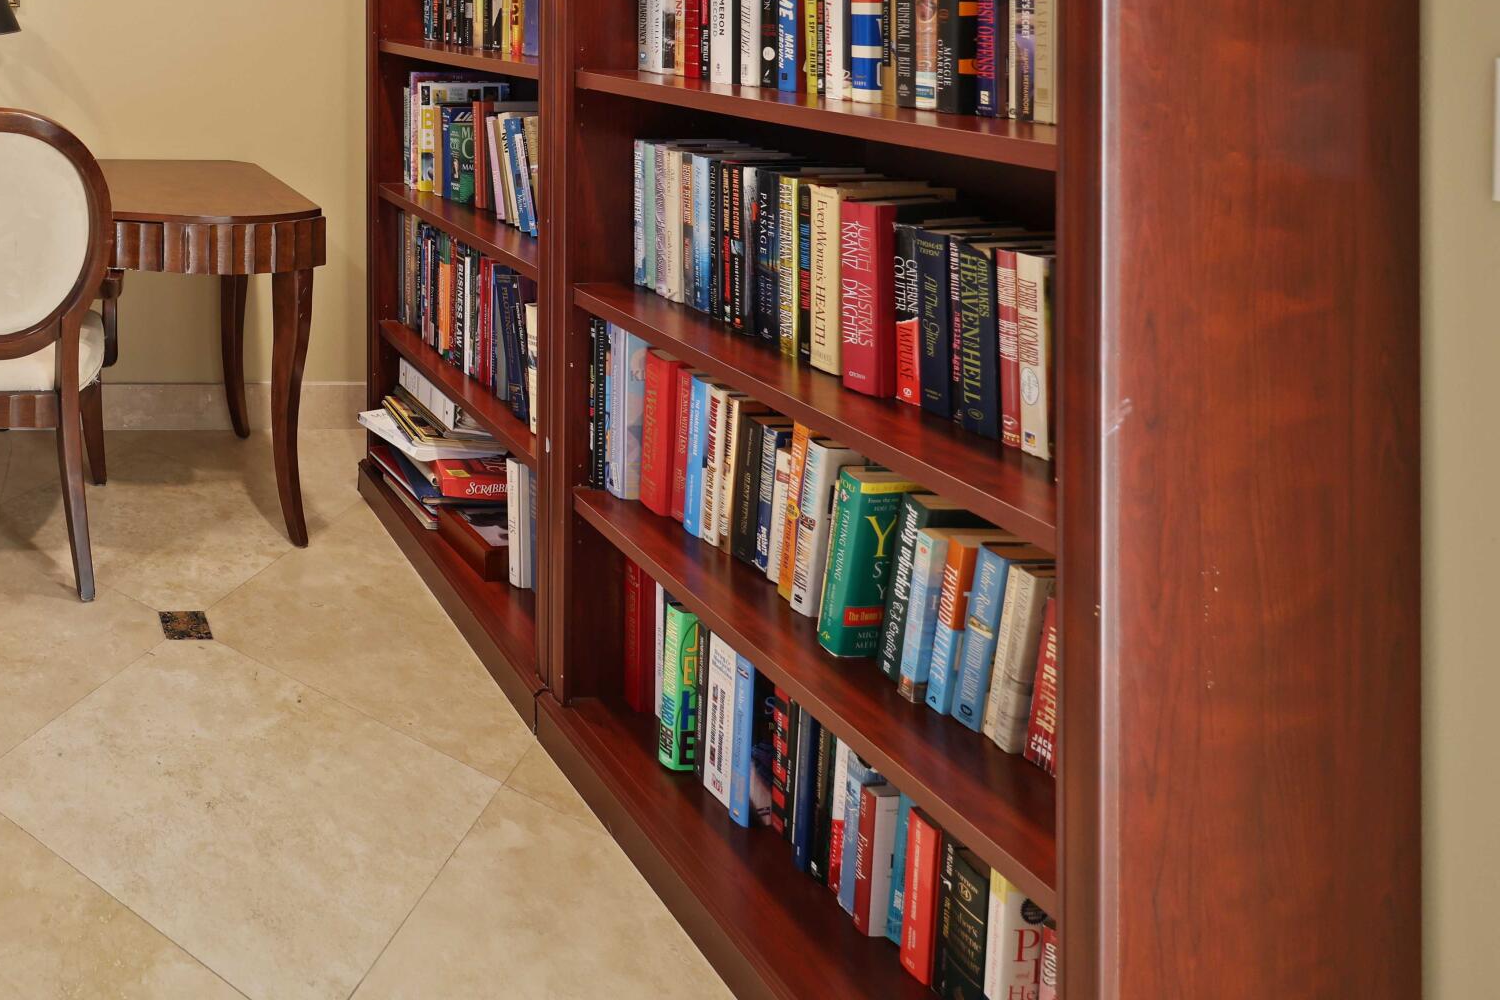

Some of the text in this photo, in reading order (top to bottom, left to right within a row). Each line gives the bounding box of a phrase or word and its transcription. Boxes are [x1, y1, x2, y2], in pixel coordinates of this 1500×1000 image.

[639, 22, 647, 46] NIXON
[741, 4, 751, 27] THE
[897, 2, 911, 40] FUNERAL
[1021, 10, 1031, 40] SECRET
[741, 28, 751, 58] EDGE
[784, 32, 795, 61] MARK
[897, 43, 910, 53] IN
[897, 56, 911, 78] BLUE
[943, 46, 952, 87] MAGGIE
[977, 25, 996, 80] OFFENSE
[634, 151, 642, 223] FACING EXTREME
[731, 168, 740, 206] NUMBERED
[732, 206, 740, 240] ACCOUNT
[760, 192, 768, 255] PASSAGE
[767, 213, 775, 238] THE
[841, 220, 858, 270] KRANTZ
[857, 222, 872, 273] JUDITH
[779, 183, 793, 339] FAYE KELLERMAN JUPITER'S BONES
[814, 199, 828, 347] EveryWoman's HEALTH
[894, 255, 906, 312] COULTER
[905, 258, 919, 314] CATHERINE
[455, 263, 464, 348] BUSINESS LAW
[501, 286, 512, 334] PILOTING
[841, 277, 858, 345] DAUGHTER
[977, 258, 990, 318] JOHN JAKES
[858, 283, 874, 347] MISTRAL'S
[959, 252, 981, 405] HEAVEN HELL
[1017, 277, 1039, 367] DEBBIE MACOMBER
[899, 325, 914, 381] IMPULSE
[643, 387, 657, 473] Webster's
[743, 471, 752, 501] SILENT
[833, 506, 850, 582] STAYING YOUNG
[929, 563, 959, 685] THYROID BALANCE
[709, 701, 718, 745] Medications
[1030, 734, 1052, 749] JACK
[1029, 742, 1051, 760] CARR
